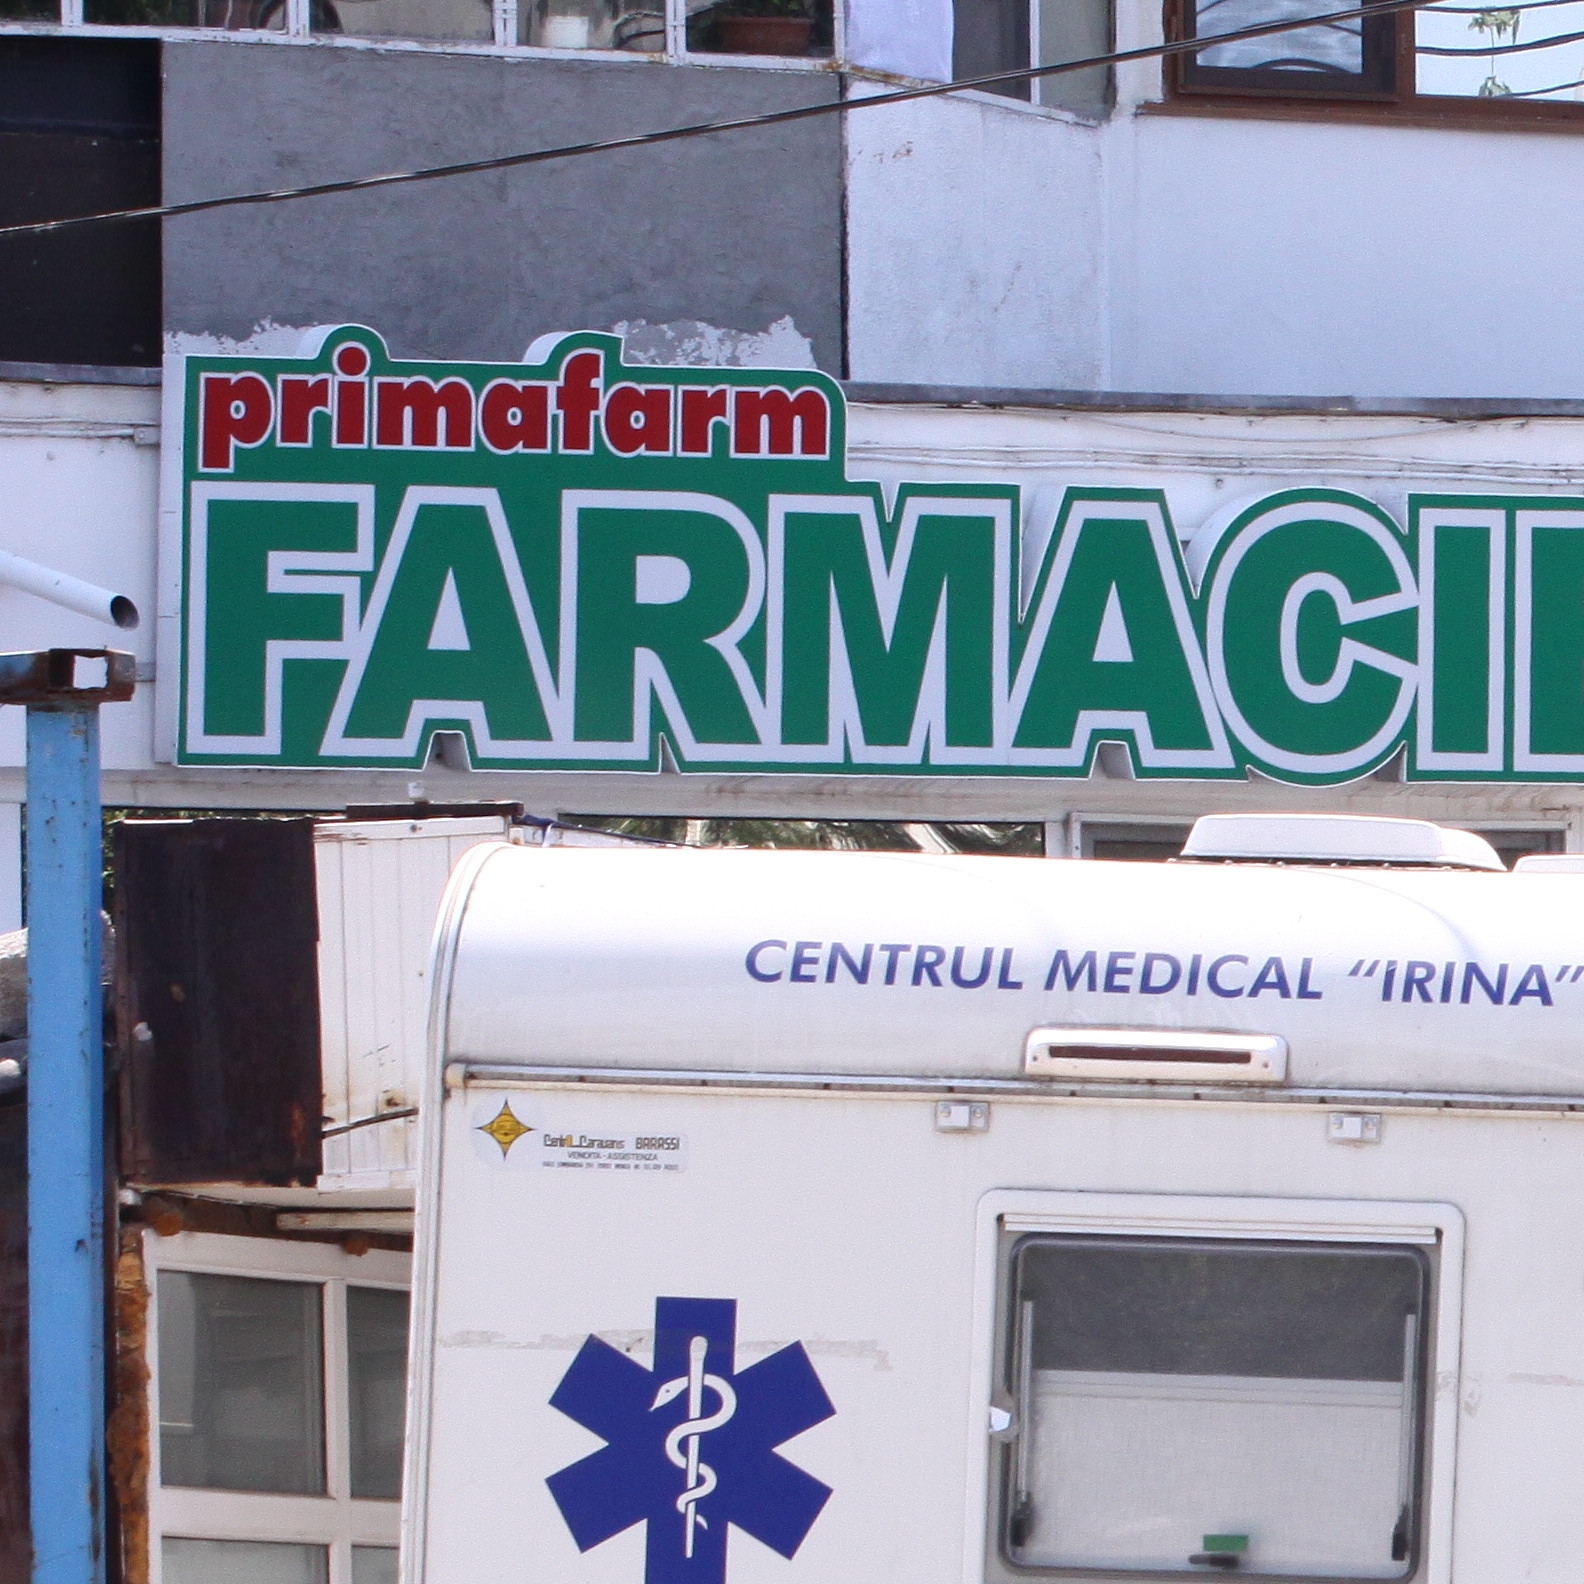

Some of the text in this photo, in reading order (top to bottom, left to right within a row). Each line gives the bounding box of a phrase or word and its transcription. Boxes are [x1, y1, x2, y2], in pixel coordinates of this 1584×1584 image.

[199, 344, 831, 472] primafarm
[745, 939, 1024, 991] CENTRUL
[1044, 949, 1324, 1001] MEDICAL
